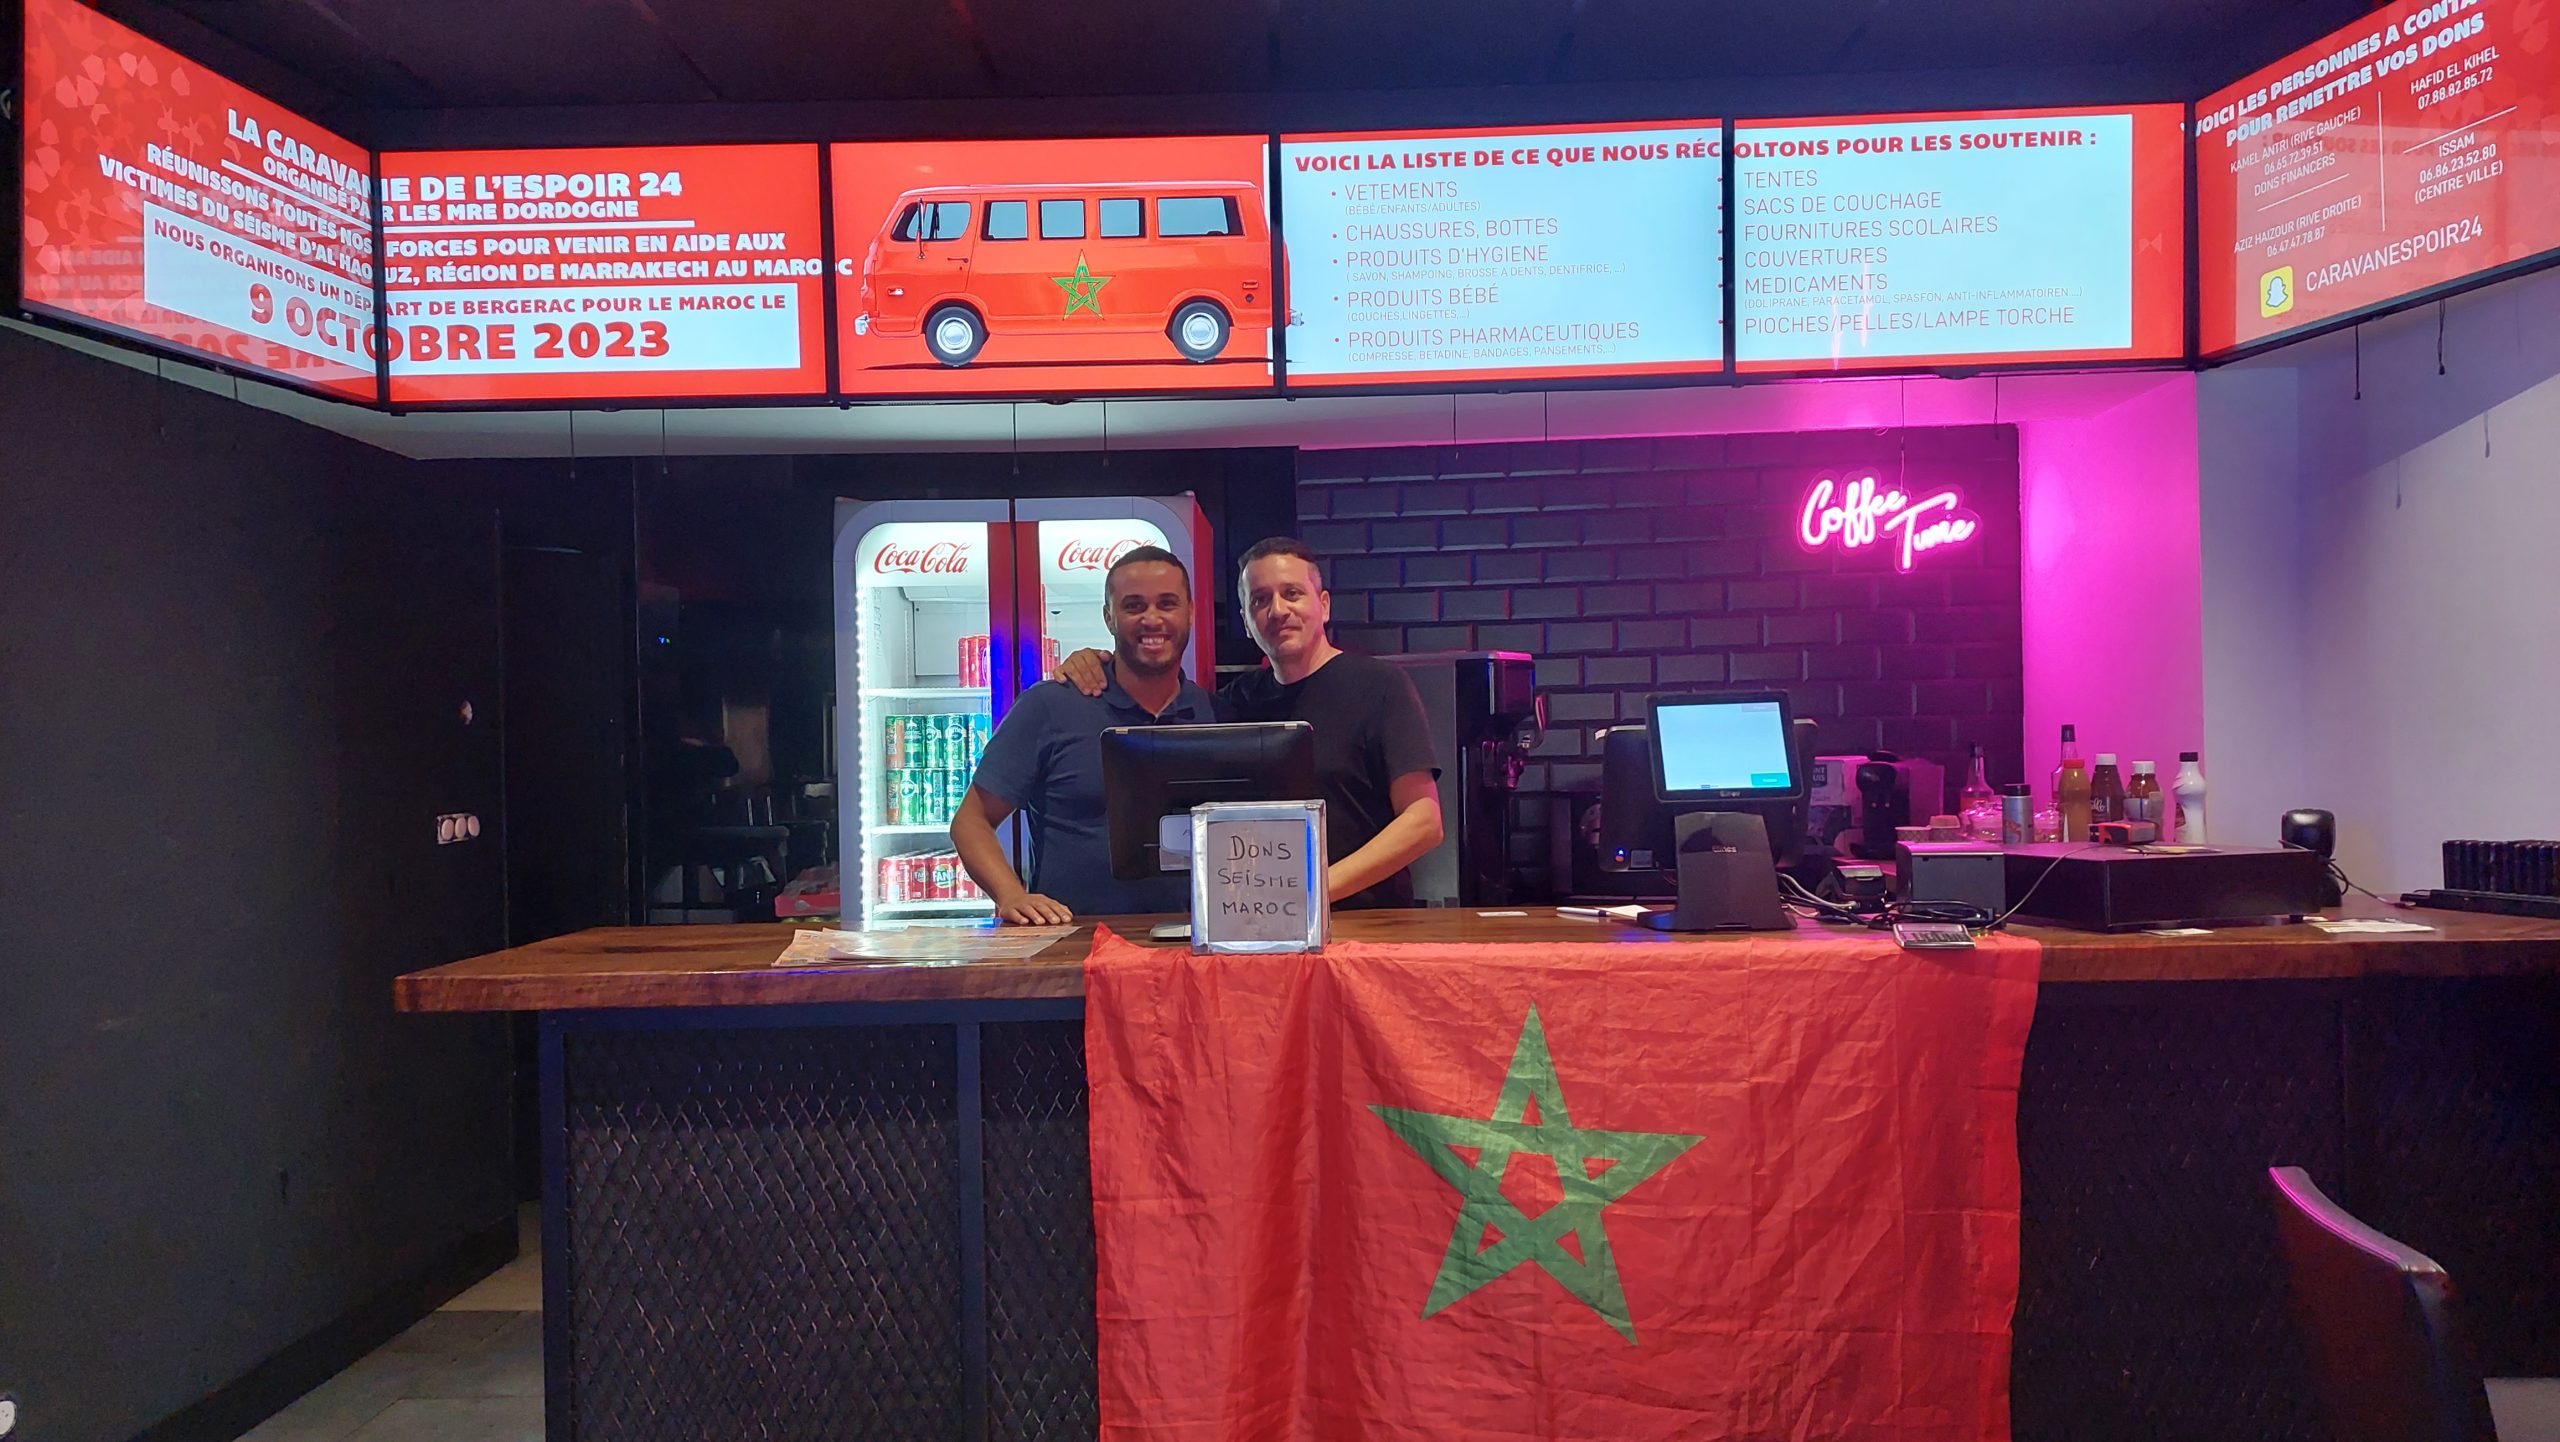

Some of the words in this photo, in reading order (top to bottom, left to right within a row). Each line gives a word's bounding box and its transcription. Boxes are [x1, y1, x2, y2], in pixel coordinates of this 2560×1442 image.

[2225, 114, 2273, 148] POUR
[2276, 64, 2372, 125] REMETTRE
[2375, 43, 2418, 78] VOS
[2421, 12, 2485, 58] DONS
[2237, 90, 2268, 116] LES
[2270, 32, 2381, 101] PERSONNES
[2384, 24, 2400, 46] A
[2410, 69, 2444, 95] HAFID
[2446, 62, 2462, 79] EL
[2463, 45, 2500, 71] KIHEL
[2417, 66, 2493, 110] 07.88.82.85.72
[228, 108, 262, 149] LA
[420, 176, 466, 201] DE
[475, 173, 631, 200] L'ESPOIR
[639, 171, 682, 197] 24
[1295, 155, 1360, 172] VOICI
[1367, 154, 1396, 170] LA
[1403, 151, 1467, 169] LISTE
[1474, 150, 1505, 167] DE
[1511, 148, 1540, 165] CE
[1546, 146, 1595, 167] QUE
[1602, 144, 1669, 162] NOUS
[1836, 136, 1904, 155] POUR
[1911, 134, 1952, 152] LES
[1959, 130, 2083, 150] SOUTENIR
[2230, 156, 2260, 174] KAMEL
[2261, 140, 2289, 161] ANTRI
[2290, 126, 2315, 148] (RIVE
[2316, 105, 2361, 135] GAUCHE)
[2438, 131, 2475, 158] ISSAM
[1744, 169, 1818, 189] TENTES
[2254, 175, 2280, 197] DONS
[2281, 153, 2336, 183] FINANCERS
[2414, 174, 2464, 204] (CENTRE
[2465, 159, 2504, 185] VILLE)
[2419, 143, 2497, 184] 06.86.23.52.80
[147, 142, 269, 212] RÉUNISSONS
[272, 198, 337, 240] TOUTES
[340, 227, 372, 255] NOS
[386, 239, 477, 258] FORCES
[483, 238, 550, 256] POUR
[555, 235, 630, 255] VENIR
[635, 235, 668, 253] EN
[672, 233, 730, 252] AIDE
[735, 232, 786, 251] AUX
[263, 156, 347, 209] ORGANISÉ
[399, 204, 441, 222] LES
[447, 203, 498, 221] MRE
[503, 200, 639, 220] DORDOGNE
[1344, 180, 1458, 201] VETEMENTS
[1744, 197, 1795, 215] SACS
[1802, 195, 1827, 213] DE
[1833, 191, 1942, 212] COUCHAGE
[98, 154, 198, 211] VICTIMES
[202, 196, 229, 223] DU
[233, 210, 296, 250] SÉISME
[426, 261, 517, 283] RÉGION
[522, 263, 555, 281] DE
[560, 261, 710, 281] MARRAKECH
[714, 260, 748, 277] AU
[1346, 220, 1480, 242] CHAUSSURES,
[1486, 217, 1558, 237] BOTTES
[1744, 220, 1883, 242] FOURNITURES
[1888, 215, 1998, 237] SCOLAIRES
[2233, 236, 2254, 254] AZIZ
[2296, 210, 2321, 232] (RIVE
[2322, 194, 2362, 220] DROITE)
[154, 217, 206, 253] NOUS
[209, 243, 316, 292] ORGANISONS
[319, 280, 340, 301] UN
[428, 301, 456, 315] DE
[463, 299, 576, 315] BERGERAC
[582, 297, 642, 312] POUR
[648, 296, 672, 311] LE
[679, 295, 755, 311] MAROC
[762, 295, 786, 309] LE
[1347, 248, 1441, 268] PRODUITS
[1448, 244, 1549, 265] D'HYGIENE
[1391, 269, 1455, 280] SHAMPOING,
[1457, 267, 1497, 278] BROSSE
[1744, 246, 1888, 268] COUVERTURES
[2305, 215, 2483, 292] CARAVANESPOIR24
[1347, 288, 1443, 308] PRODUITS
[1449, 282, 1499, 305] BÉBÉ
[1744, 273, 1888, 295] MEDICAMENTS
[250, 283, 274, 325] 9
[533, 320, 670, 358] 2023
[1348, 328, 1443, 348] PRODUITS
[1450, 321, 1640, 345] PHARMACEUTIQUES
[1996, 306, 2075, 326] TORCHE
[1801, 476, 1908, 549] Coffee
[1883, 491, 1976, 570] Time
[873, 541, 973, 575] Coca-Cola
[1226, 835, 1292, 861] DONS
[1222, 901, 1297, 917] MAROC
